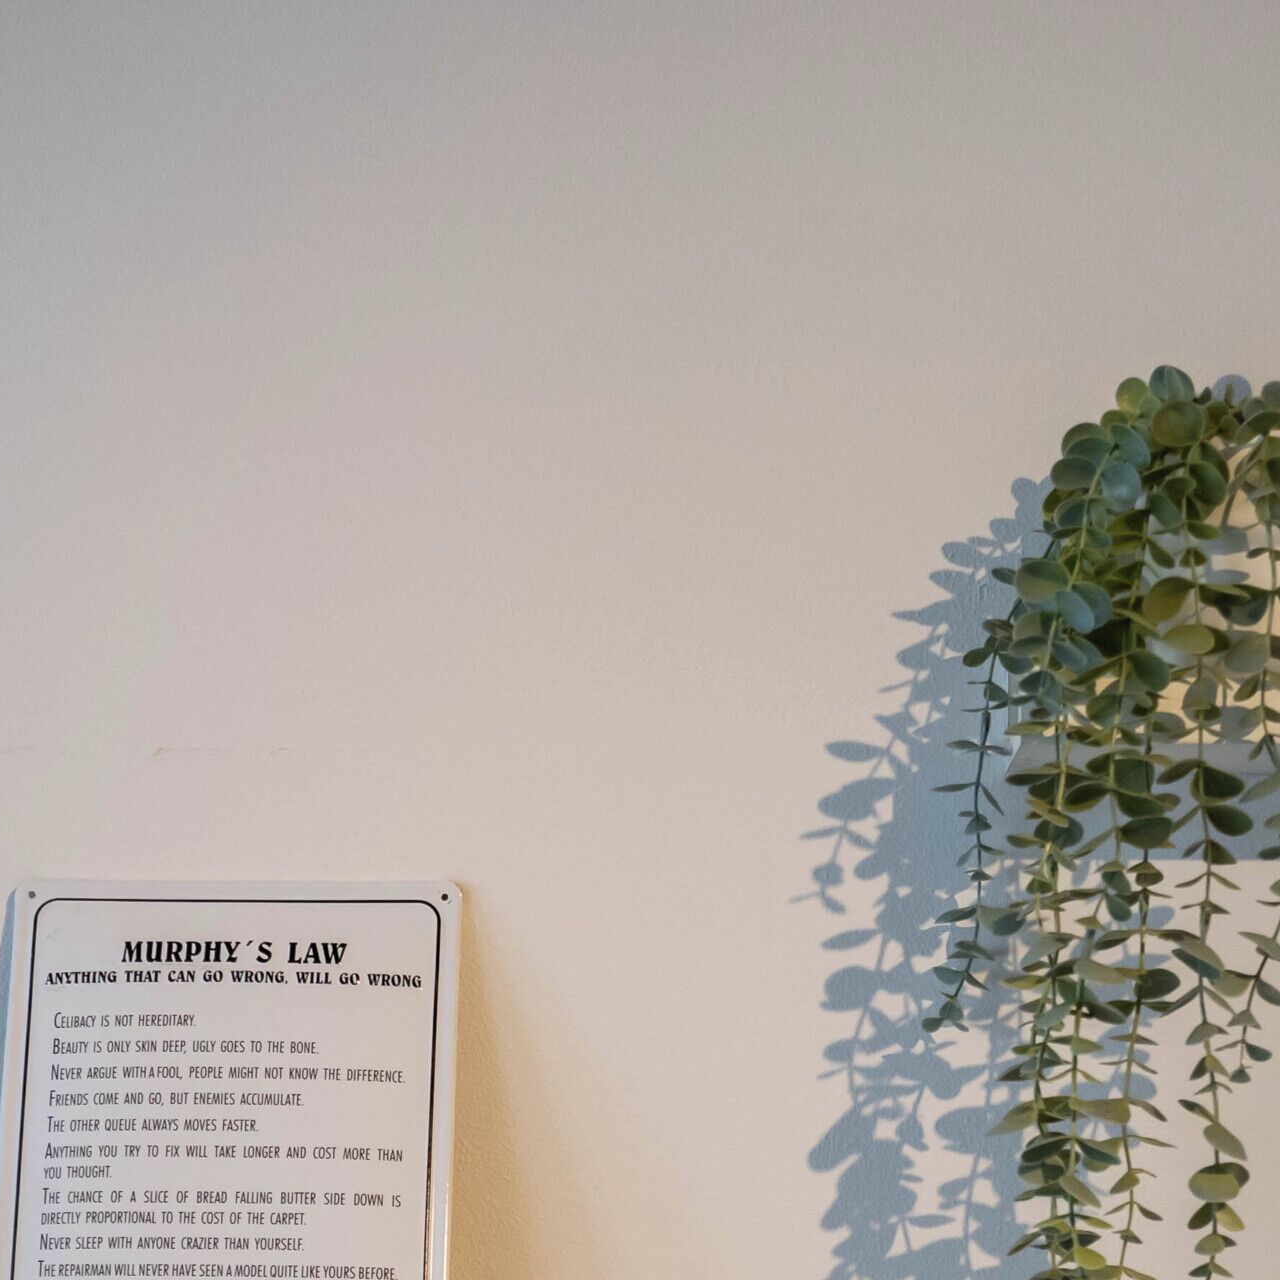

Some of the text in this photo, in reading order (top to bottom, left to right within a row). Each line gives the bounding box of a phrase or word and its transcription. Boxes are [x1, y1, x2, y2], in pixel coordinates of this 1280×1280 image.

[287, 942, 348, 965] LAW
[45, 970, 422, 989] ANYTHING THAT CAN GO WRONG, WILL GO WRONG
[53, 1011, 197, 1029] CELIBACY IS NOT HEREDITARY.
[52, 1037, 319, 1055] BEAUTY IS ONLY SKIN DEEP, UGLY GOES TO THE BONE.
[49, 1089, 305, 1107] FRIENDS COME AND GO, BUT ENEMIES ACCUMULATE.
[47, 1115, 259, 1133] THE OTHER QUEUE ALWAYS MOVES FASTER.
[44, 1142, 403, 1162] ANYTHING YOU TRY TO FIX WILL TAKE LONGER AND COST MORE THAN
[43, 1165, 112, 1180] YOU THOUGHT.
[42, 1187, 402, 1208] THE CHANCE OF A SLICE OF BREAD FALLING BUTTER SIDE DOWN IS
[40, 1210, 307, 1226] DIRECTLY PROPORTIONAL TO THE COST OF THE CARPET.
[39, 1233, 305, 1251] NEVER SLEEP WITH ANYONE CRAZIER THAN YOURSELF.
[37, 1259, 398, 1280] THE REPAIRMAN WILL NEVER HAVE SEEN A MODEL QUITE LIKE YOURS BEFORE.
